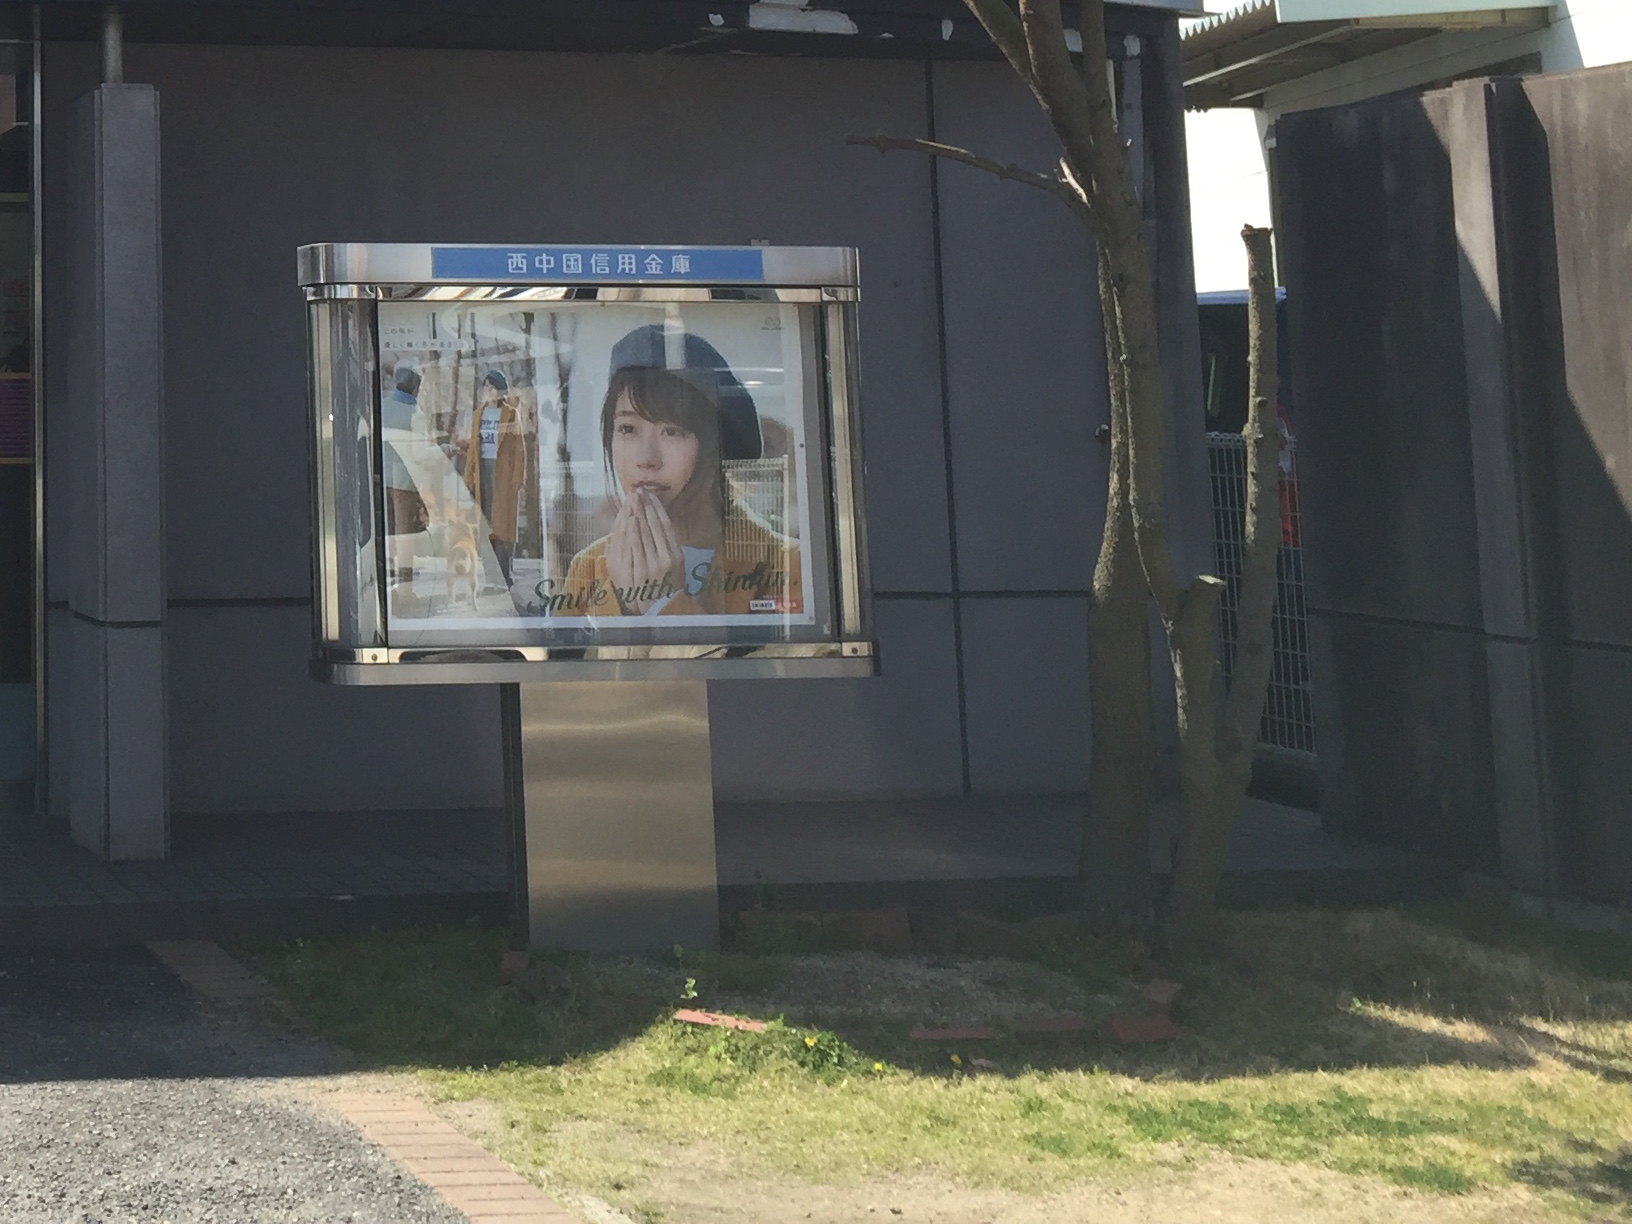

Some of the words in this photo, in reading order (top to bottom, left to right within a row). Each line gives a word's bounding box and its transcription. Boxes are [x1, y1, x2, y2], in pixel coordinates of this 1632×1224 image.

[506, 252, 693, 276] 西中国信用金庫
[526, 579, 608, 614] Smile
[615, 571, 674, 604] with
